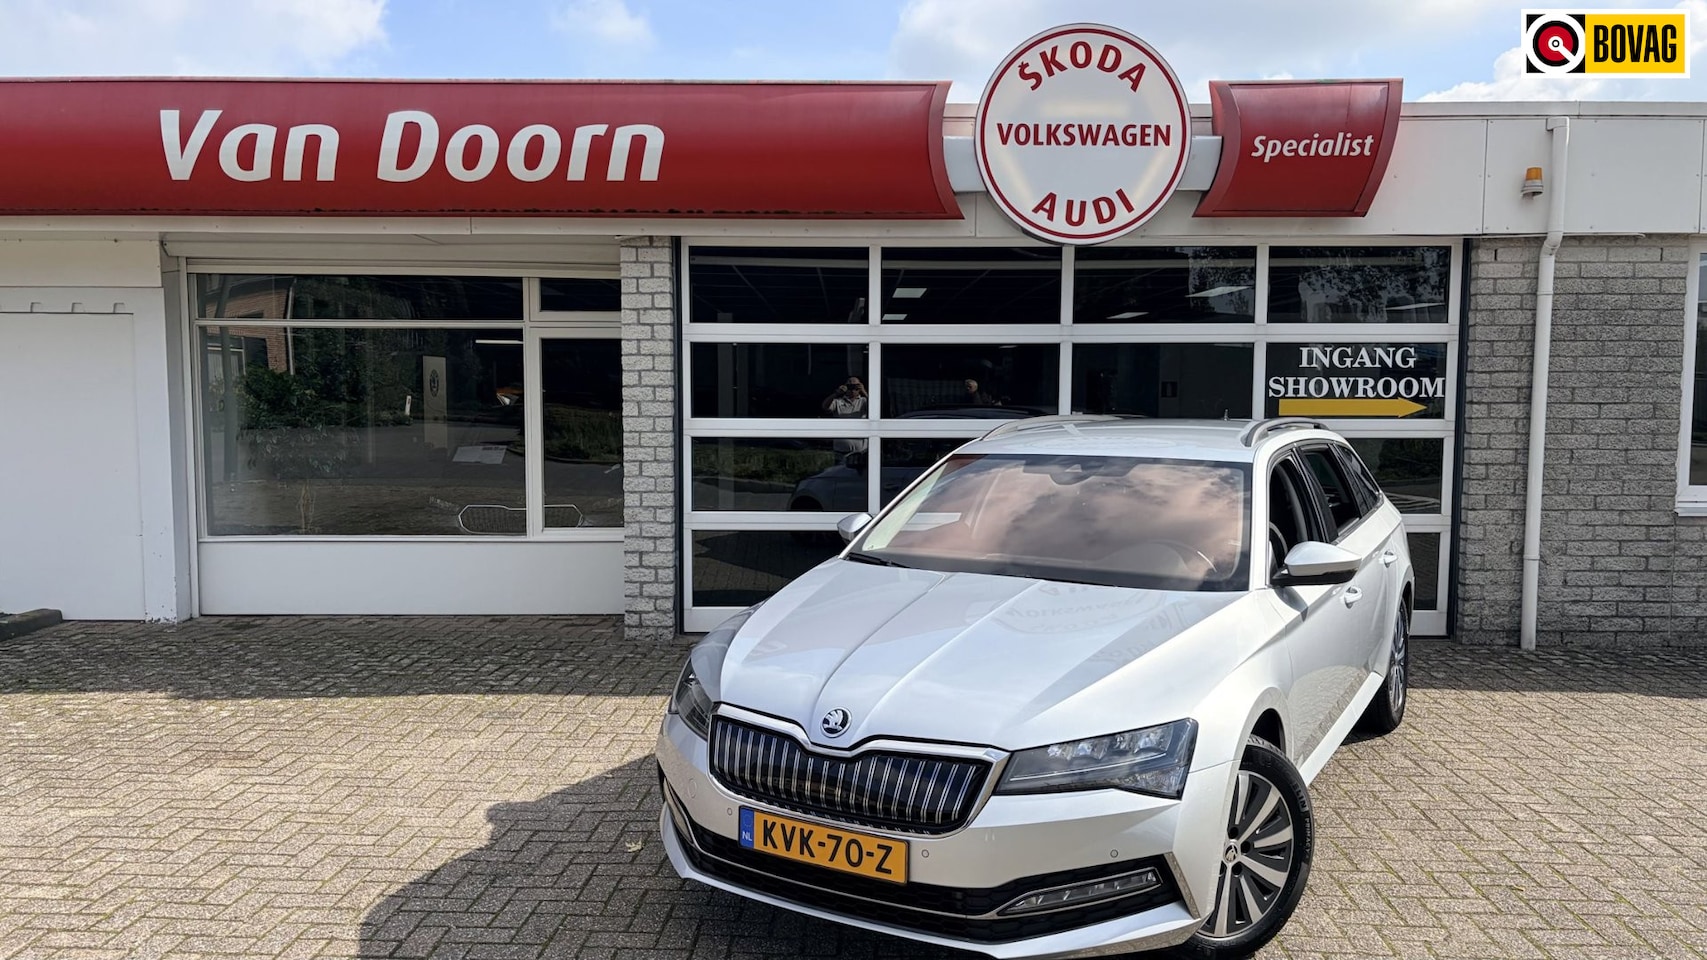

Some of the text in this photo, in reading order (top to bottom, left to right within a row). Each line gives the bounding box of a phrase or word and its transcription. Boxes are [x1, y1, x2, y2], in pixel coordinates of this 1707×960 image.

[1017, 41, 1146, 92] ŠKODA
[159, 109, 665, 182] Van Doorn
[996, 123, 1171, 147] VOLKSWAGEN
[1251, 132, 1375, 163] Specialist
[1032, 188, 1135, 227] AUDI
[1299, 347, 1417, 368] INGANG
[1268, 376, 1446, 398] SHOWROOM
[742, 831, 753, 842] NL
[763, 819, 893, 875] KVK-70-Z
